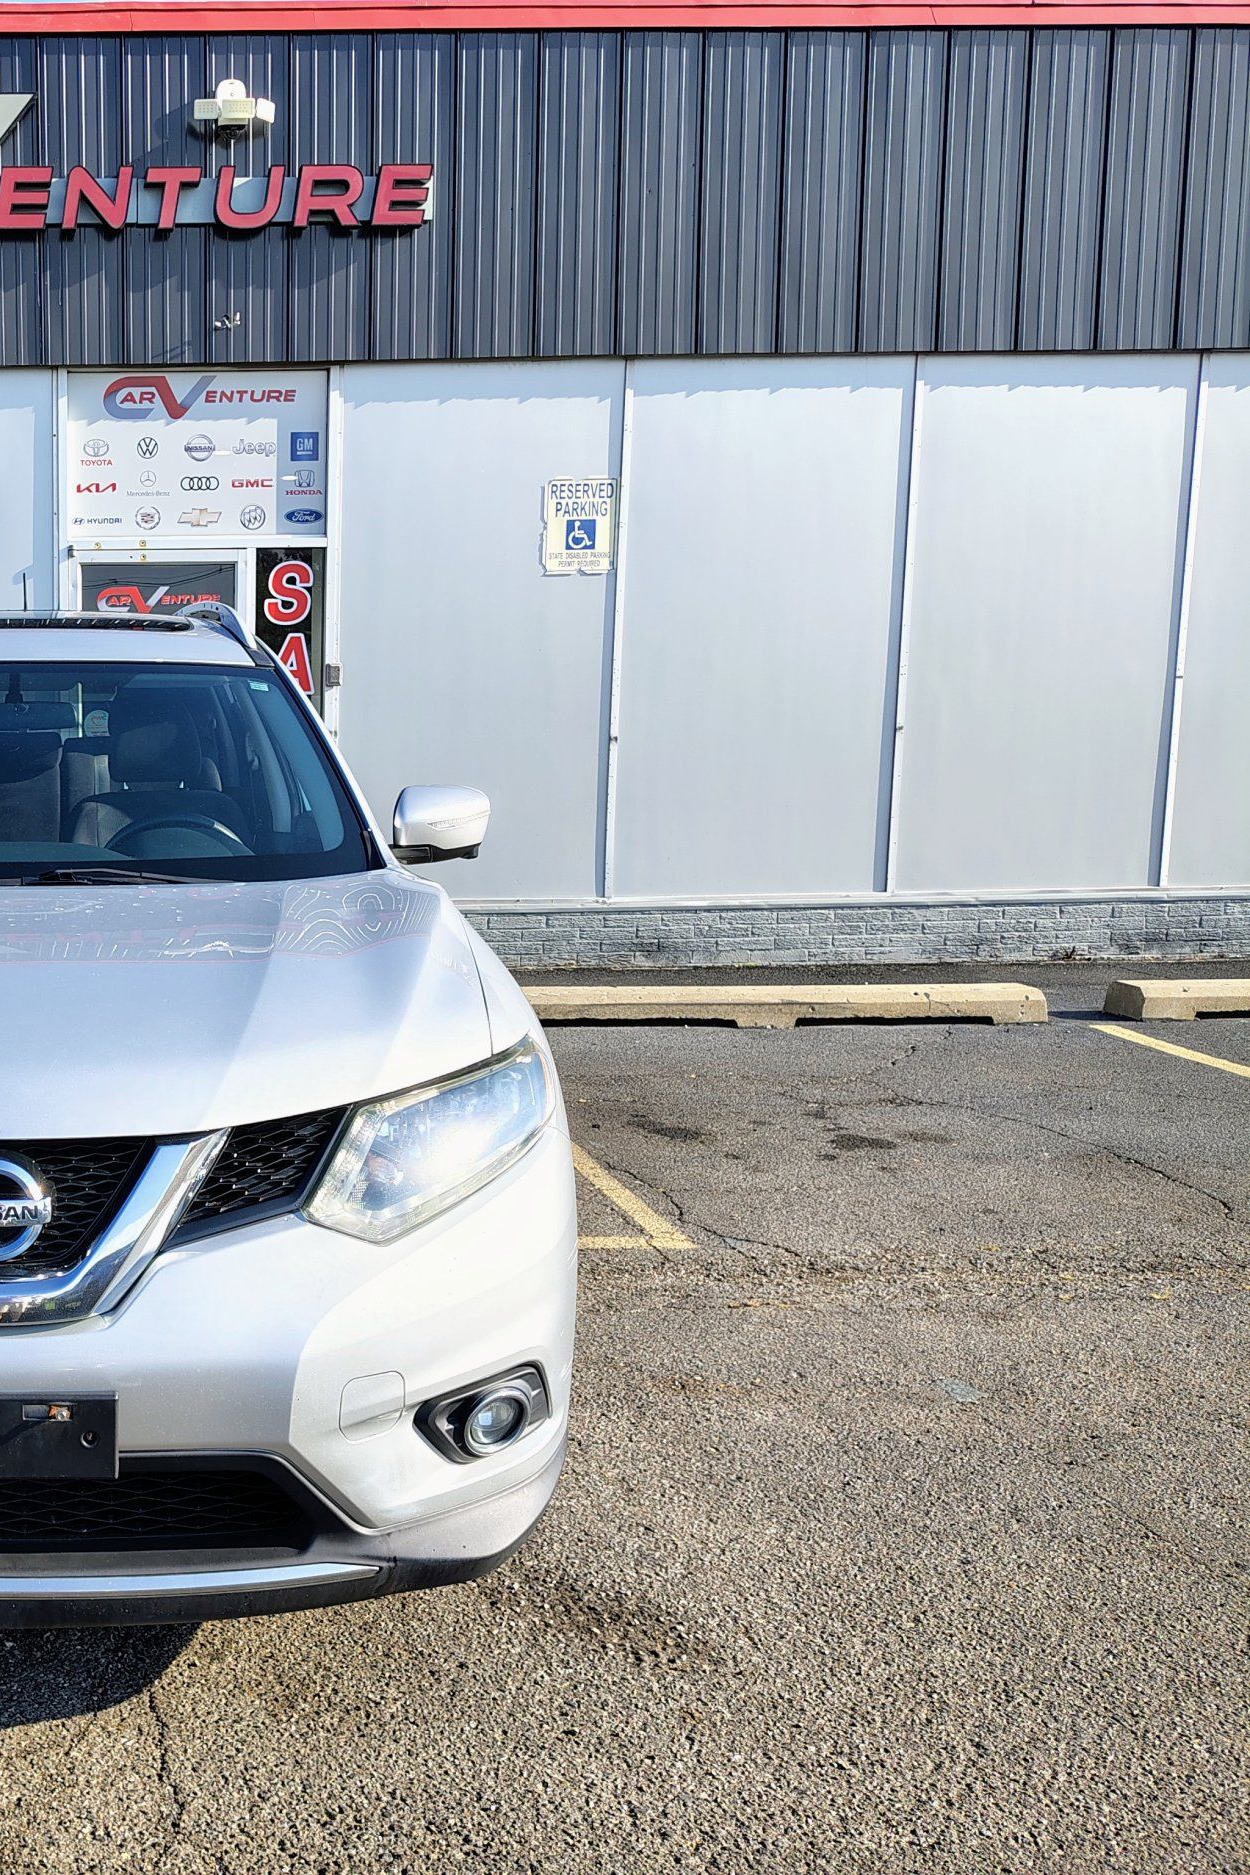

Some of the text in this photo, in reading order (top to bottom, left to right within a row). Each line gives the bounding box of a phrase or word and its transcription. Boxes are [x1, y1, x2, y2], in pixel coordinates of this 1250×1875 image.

[232, 439, 276, 457] Jeep
[296, 438, 313, 451] GM
[80, 459, 113, 467] TOYOTA
[76, 482, 117, 493] KIA
[231, 478, 274, 488] GMC
[550, 483, 614, 500] RESERVED
[555, 501, 608, 517] PARKING
[87, 517, 123, 525] HYUNDAI
[292, 511, 317, 522] Ford
[548, 551, 611, 560] STATE DISABLED PARKING
[558, 560, 575, 568] PERMIT
